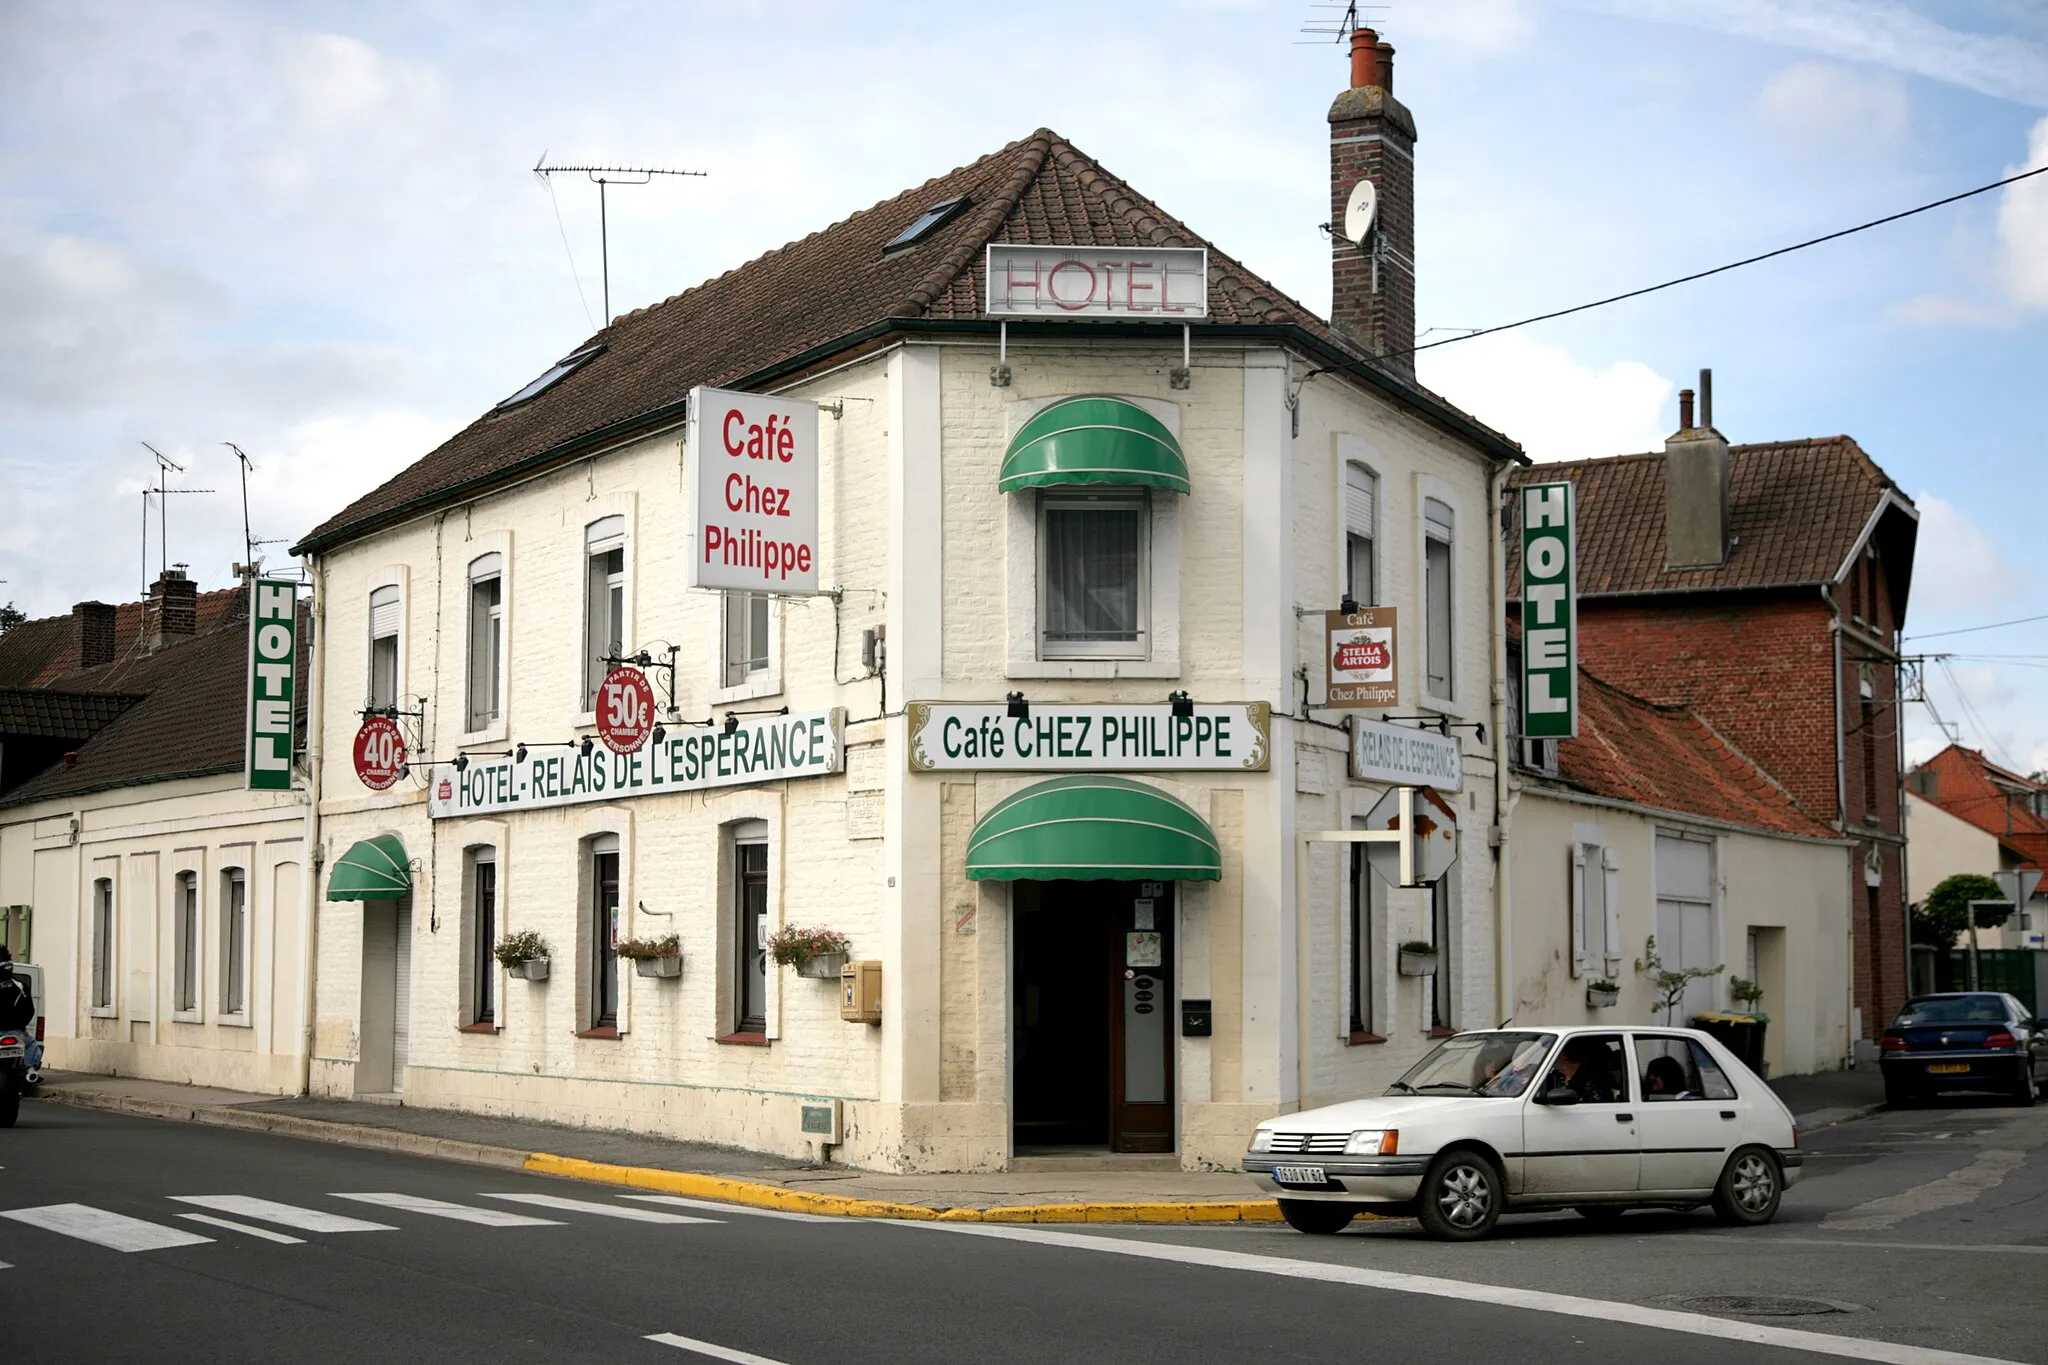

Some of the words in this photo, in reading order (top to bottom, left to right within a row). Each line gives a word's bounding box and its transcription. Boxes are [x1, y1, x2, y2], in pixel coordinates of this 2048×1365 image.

[1007, 259, 1185, 312] HOTEL
[723, 409, 795, 463] Café
[725, 473, 791, 517] Chez
[705, 525, 812, 581] Philippe
[1346, 612, 1375, 626] Café
[1525, 486, 1568, 714] HOTEL
[1342, 647, 1381, 657] STELLA
[1342, 656, 1382, 666] ARTOIS
[255, 585, 293, 771] HOTEL
[604, 683, 610, 691] A
[608, 670, 640, 684] PARTIR
[639, 680, 650, 693] DE
[1329, 687, 1354, 701] Chez
[1356, 686, 1396, 703] Philippe
[607, 684, 649, 729] 50€
[364, 722, 392, 734] PARTIR
[391, 730, 400, 741] DE
[604, 729, 650, 752] PERSONNES
[610, 728, 639, 736] CHAMBRE
[943, 715, 1005, 758] Café
[1014, 716, 1093, 758] CHEZ
[1102, 716, 1232, 758] PHILIPPE
[532, 750, 606, 800] RELAIS
[614, 746, 643, 790] DE
[651, 716, 826, 785] L'ESPERANCE
[1362, 730, 1391, 769] RELAIS
[1392, 735, 1404, 771] DE
[1404, 739, 1455, 779] L'ESPERANCE
